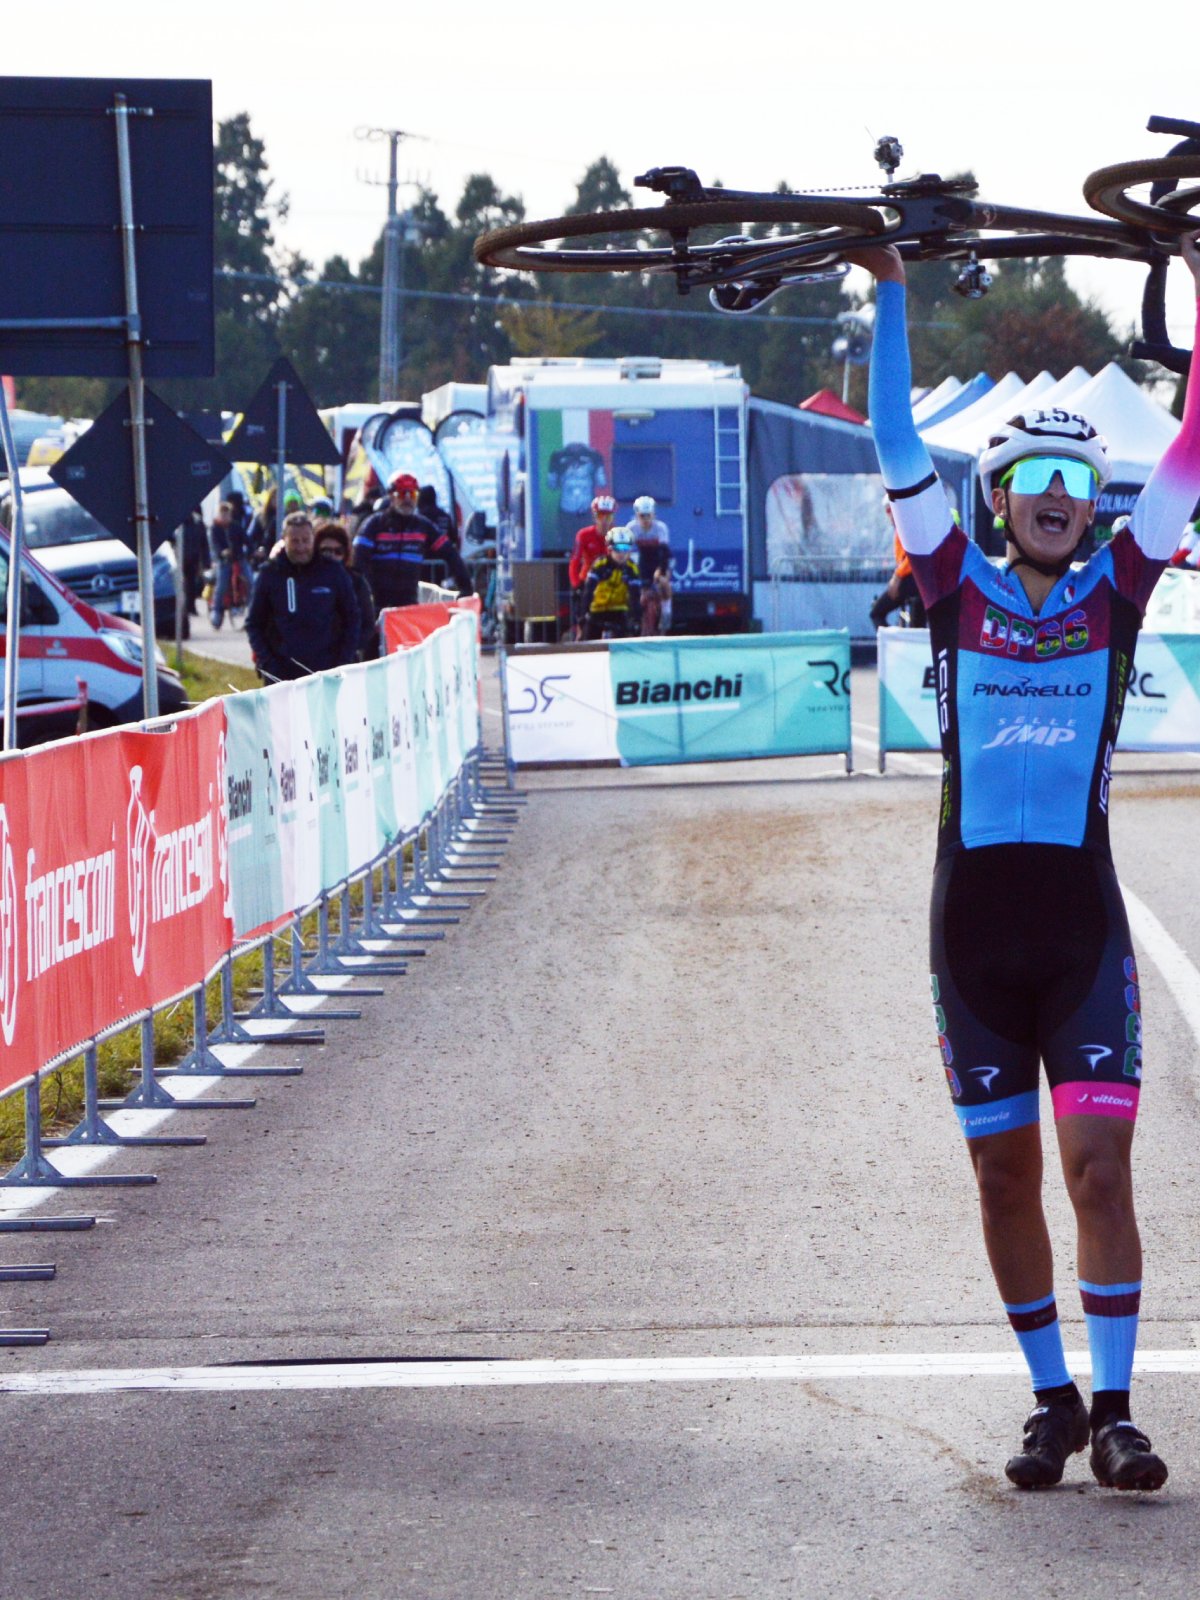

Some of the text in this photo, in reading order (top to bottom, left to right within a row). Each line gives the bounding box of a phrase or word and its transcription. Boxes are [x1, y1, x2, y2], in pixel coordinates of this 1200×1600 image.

[980, 605, 1089, 657] DP66
[616, 673, 743, 705] Bianchi
[973, 682, 1092, 698] PINARELLO
[998, 716, 1077, 727] SELLE
[982, 724, 1077, 749] SMP
[25, 819, 115, 983] francesconi
[1092, 1094, 1134, 1108] vittoria
